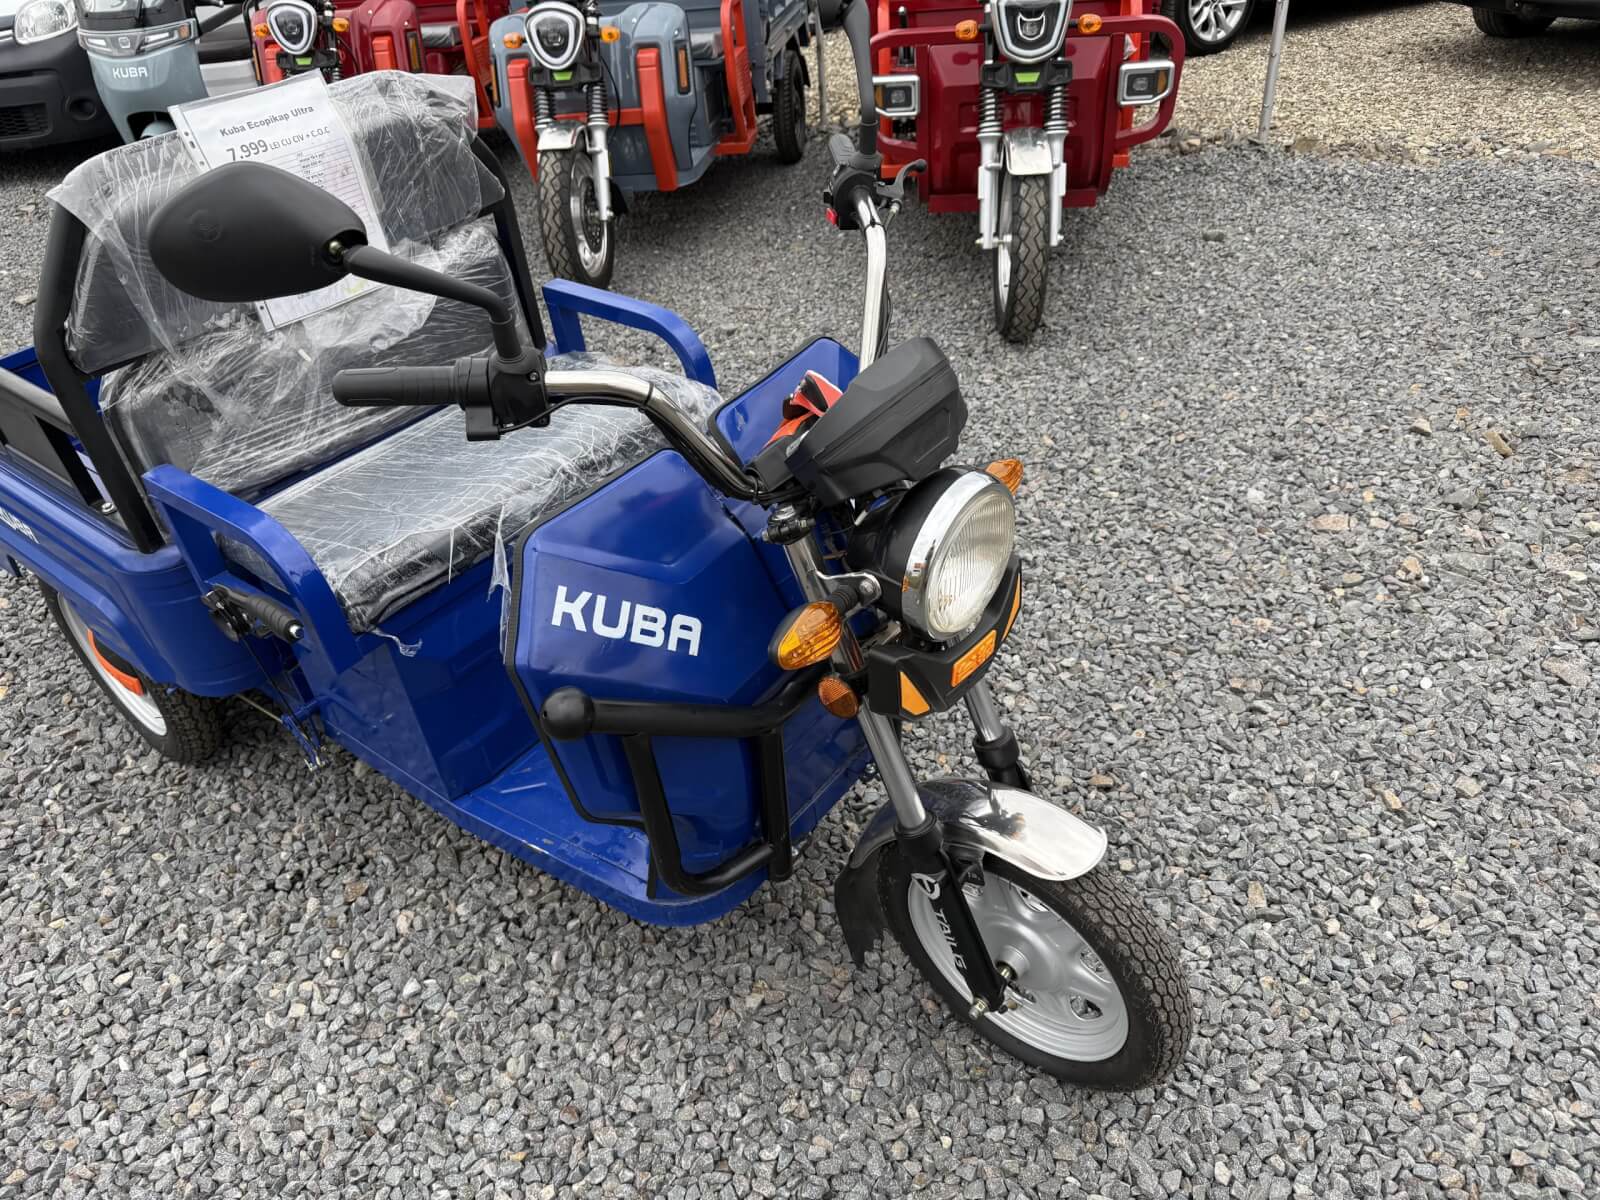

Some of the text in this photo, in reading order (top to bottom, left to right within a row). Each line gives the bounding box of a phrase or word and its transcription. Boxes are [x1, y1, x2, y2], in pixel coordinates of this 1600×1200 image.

[112, 66, 148, 79] KUBA
[219, 105, 315, 137] Kuba Ecopikap Ultra
[226, 139, 269, 161] 7.999
[269, 141, 281, 150] LEI
[281, 137, 292, 147] CU
[293, 134, 304, 144] CIV
[551, 585, 702, 656] KUBA
[935, 908, 968, 970] TAILG
